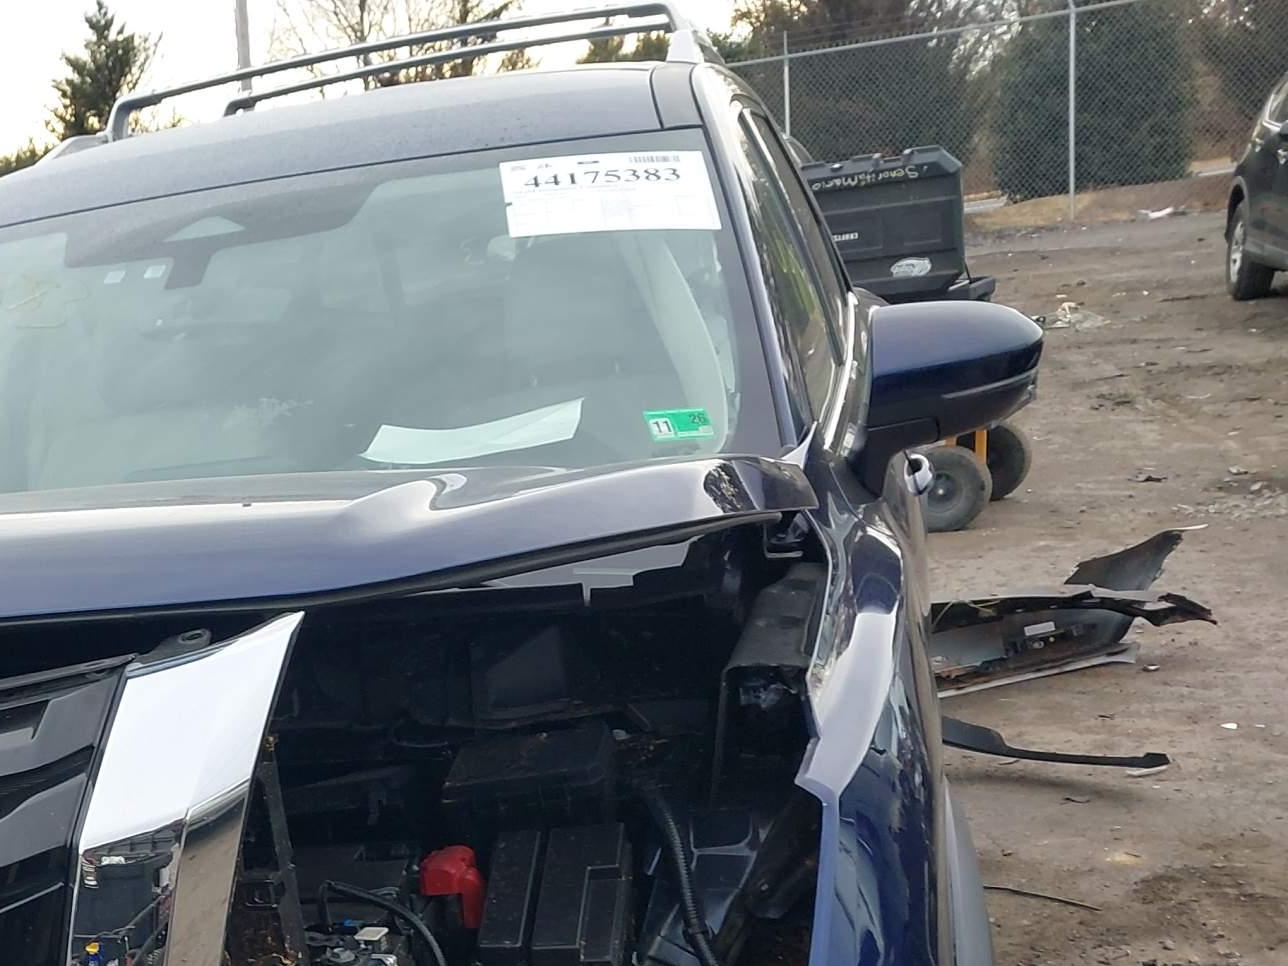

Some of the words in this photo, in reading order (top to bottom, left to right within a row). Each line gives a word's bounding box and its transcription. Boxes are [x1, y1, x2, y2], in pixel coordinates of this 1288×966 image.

[523, 167, 681, 188] 44175383
[652, 420, 672, 433] 11
[689, 413, 706, 424] 26
